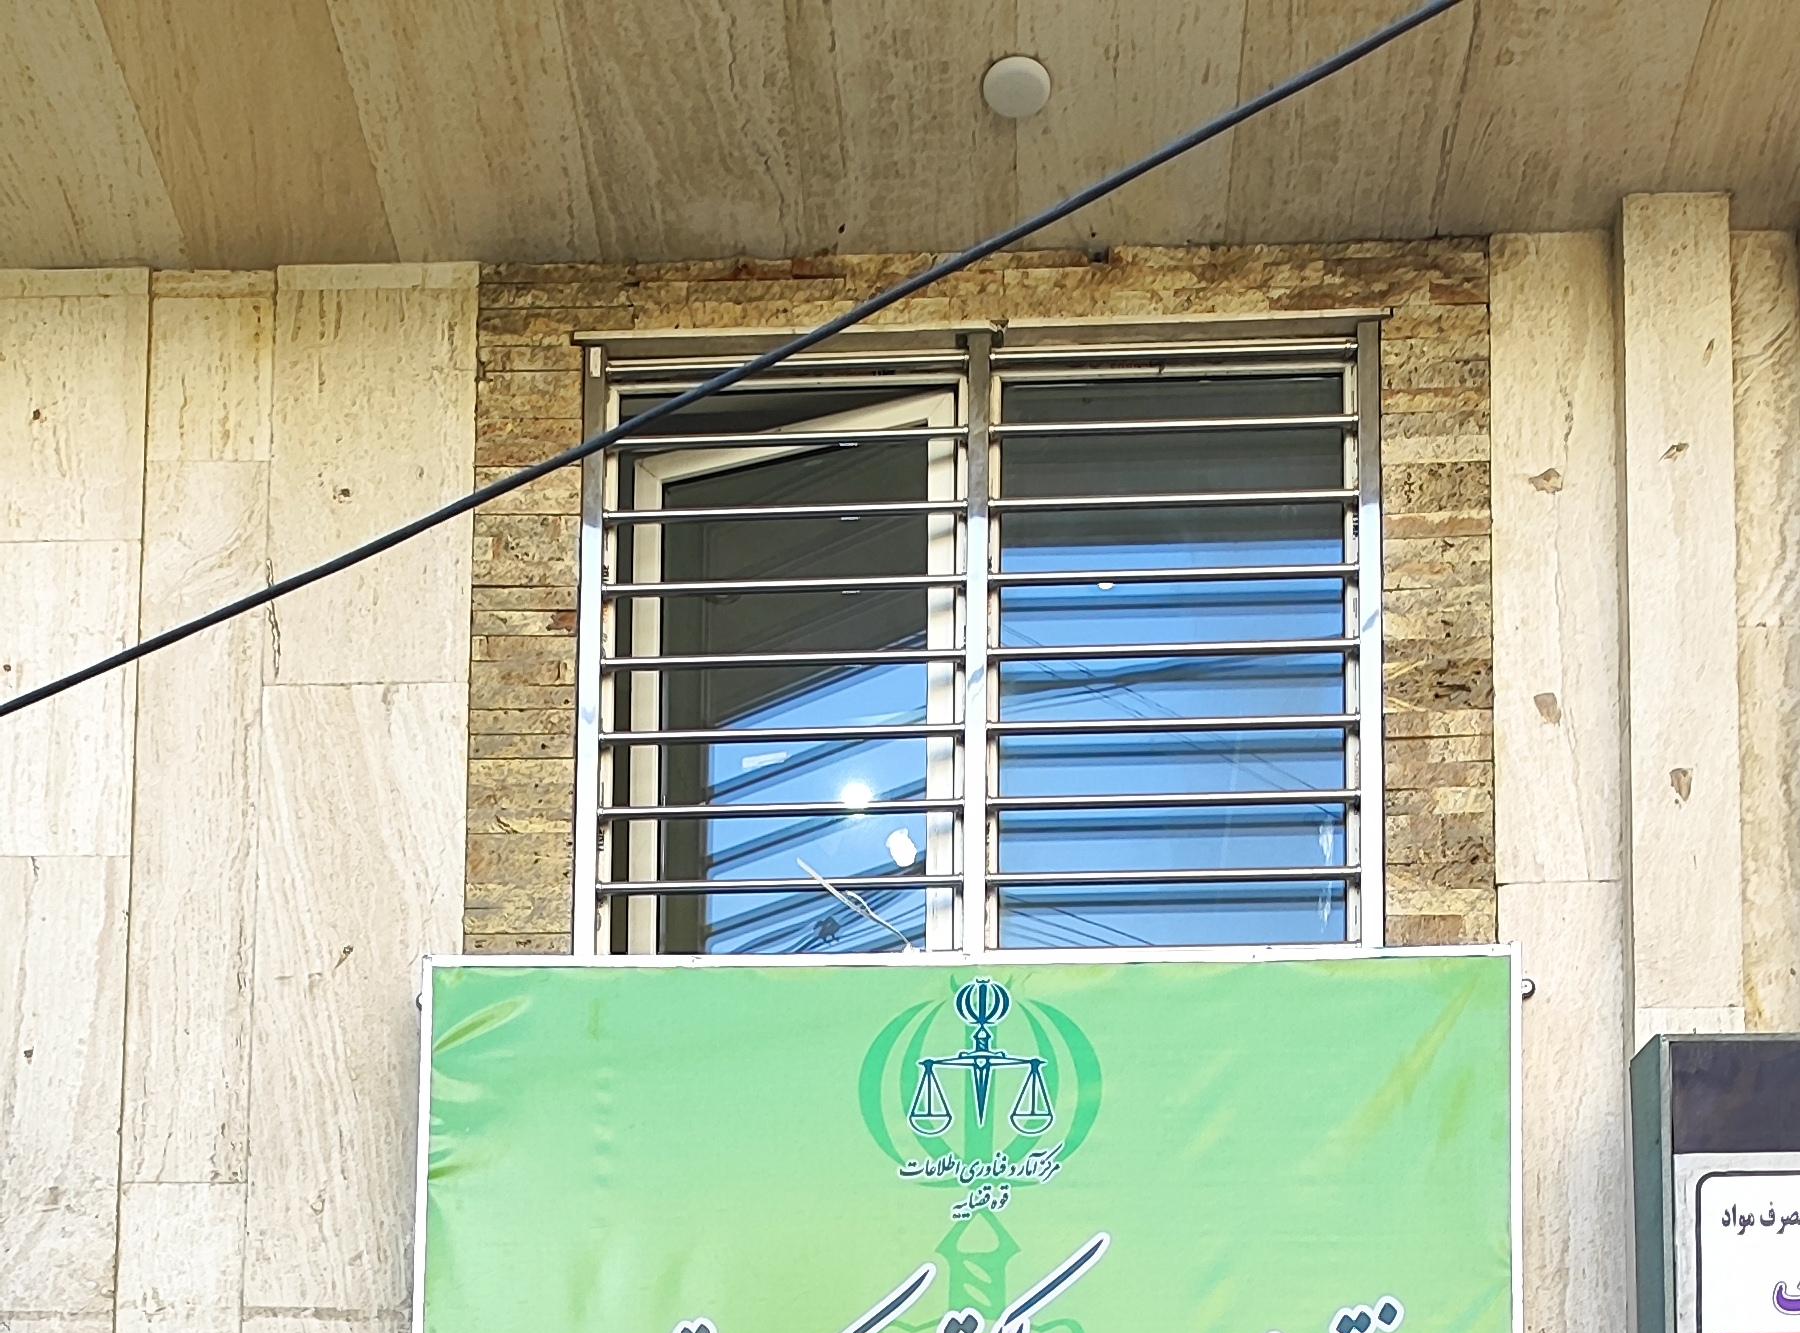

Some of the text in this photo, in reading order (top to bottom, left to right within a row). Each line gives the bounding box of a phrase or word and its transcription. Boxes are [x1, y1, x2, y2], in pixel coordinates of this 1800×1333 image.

[899, 1153, 961, 1178] اطلاعات
[959, 1151, 1007, 1184] فناوری
[1016, 1150, 1047, 1178] آمار
[1038, 1143, 1063, 1183] مرکز
[990, 1184, 1010, 1210] قوه
[1721, 1201, 1800, 1236] صرف مواد
